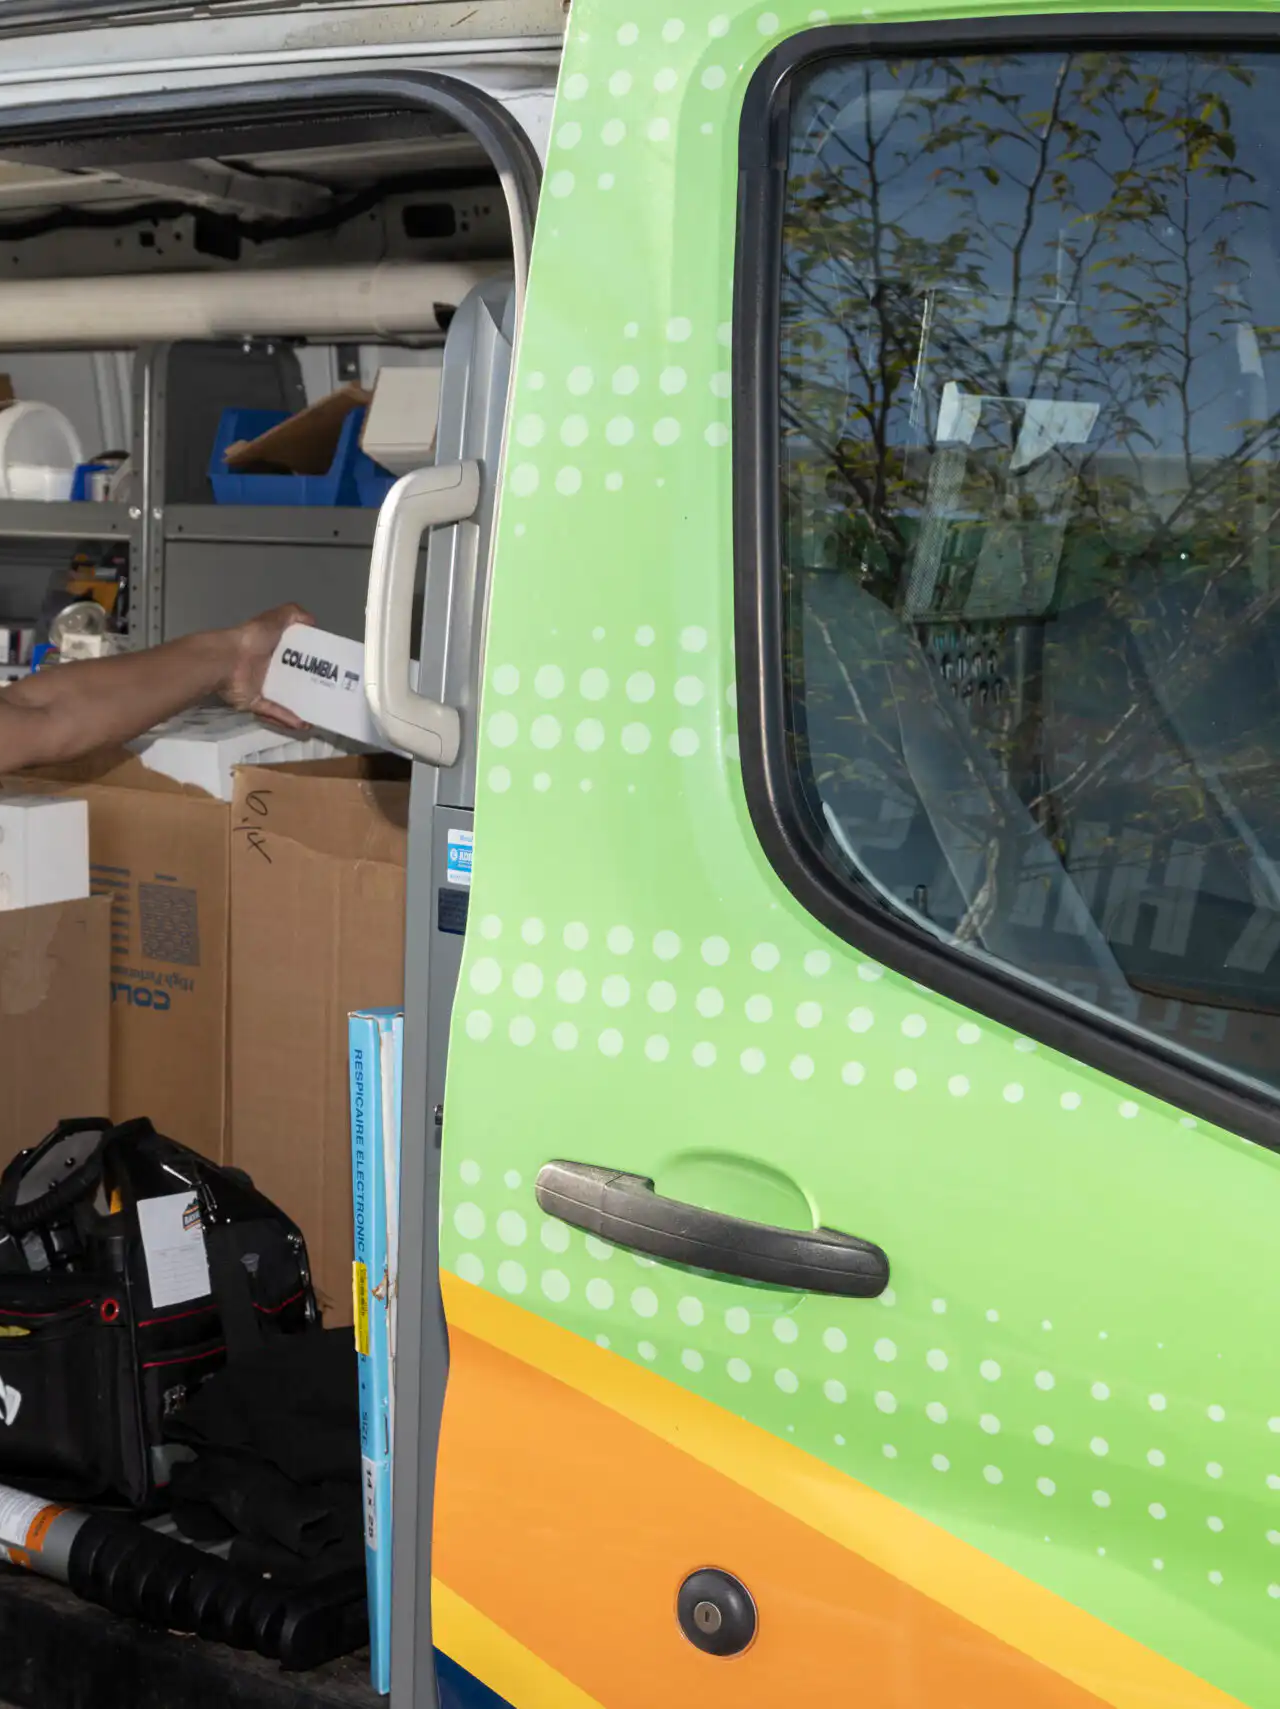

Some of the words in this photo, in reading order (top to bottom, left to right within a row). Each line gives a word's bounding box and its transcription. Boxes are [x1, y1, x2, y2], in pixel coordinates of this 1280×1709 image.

[281, 648, 339, 683] COLUMBIA
[354, 1048, 365, 1145] RESPICAIRE
[356, 1149, 366, 1253] ELECTRONIC
